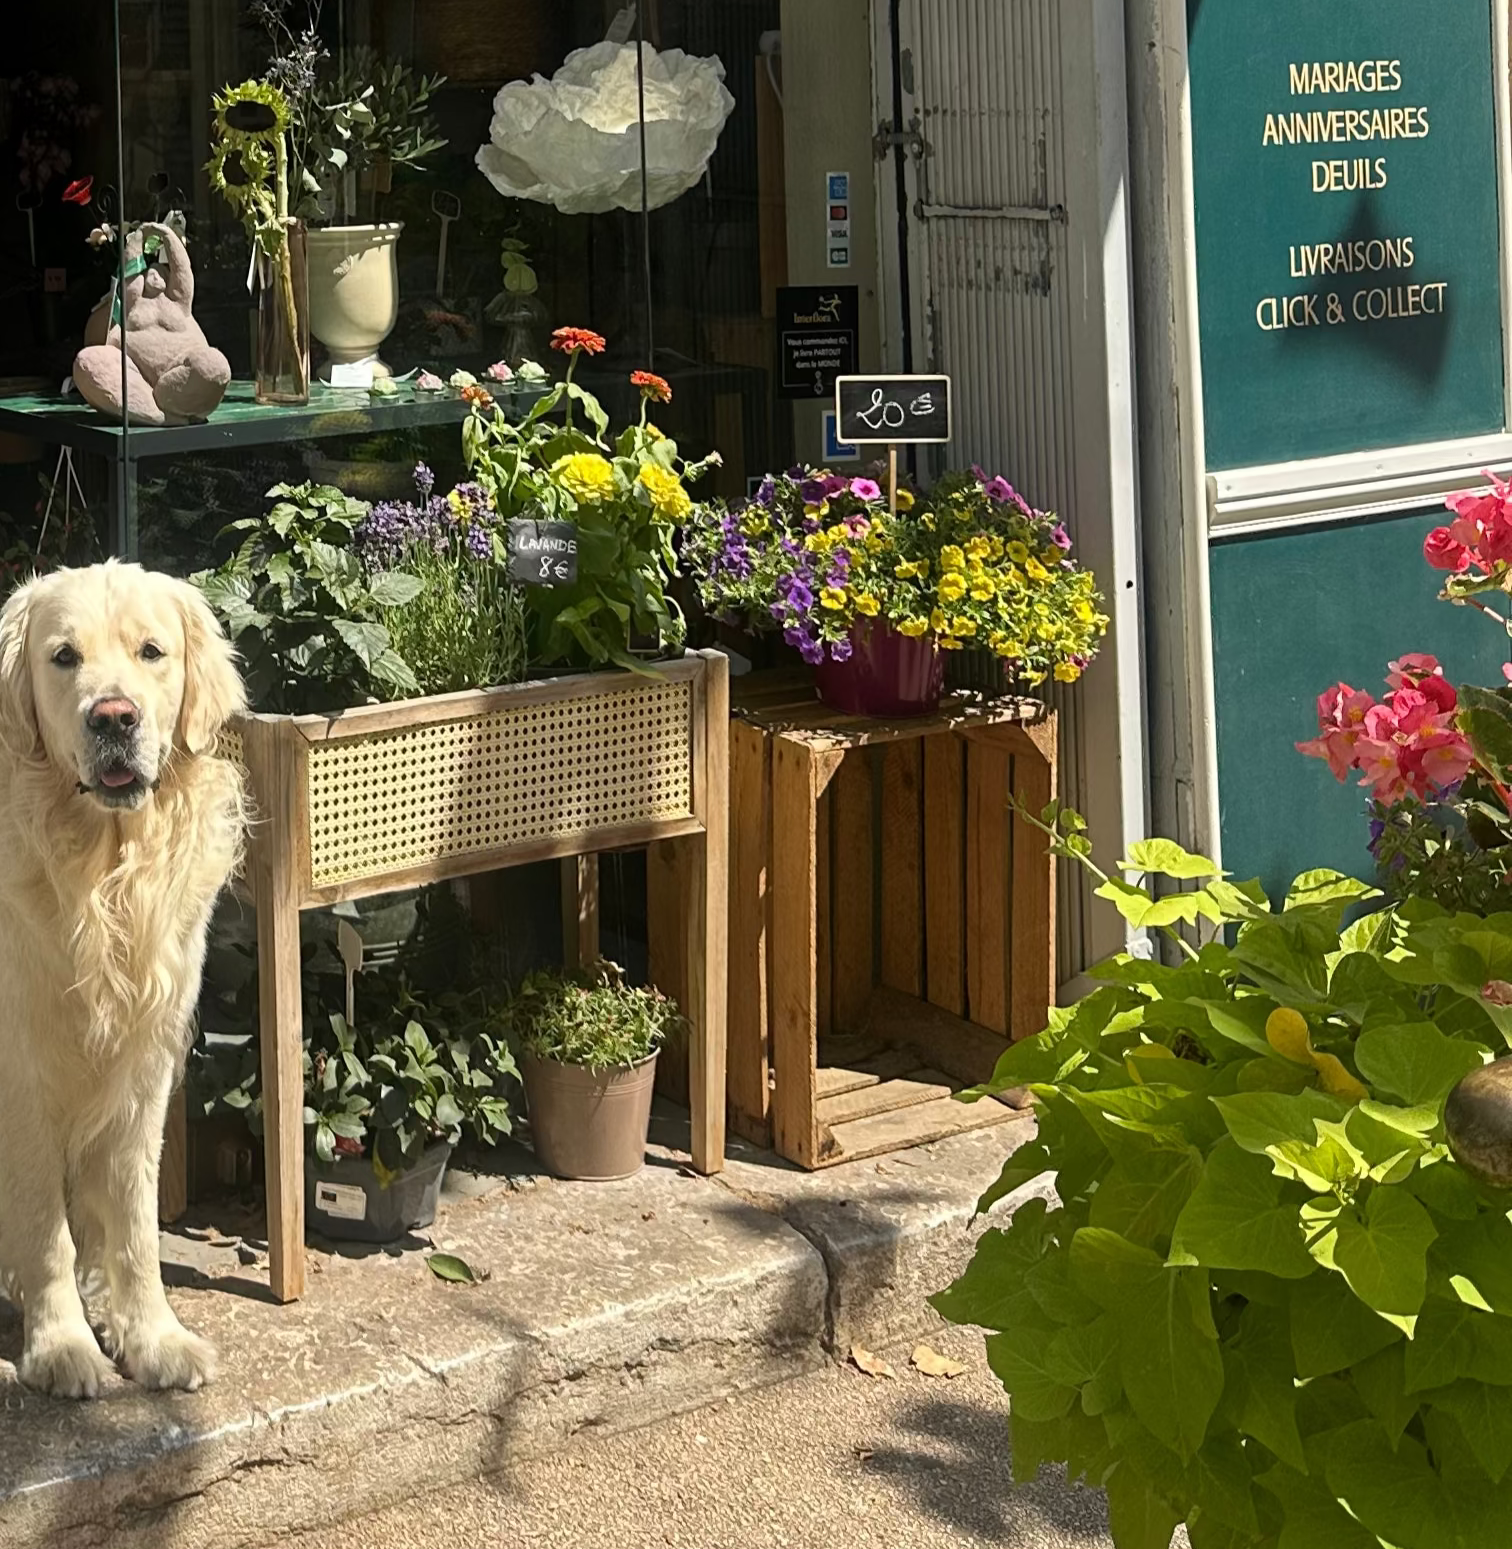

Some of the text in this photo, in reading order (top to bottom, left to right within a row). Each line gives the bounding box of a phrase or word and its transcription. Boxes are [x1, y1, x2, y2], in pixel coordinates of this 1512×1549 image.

[1289, 60, 1402, 94] MARIAGES
[1263, 107, 1429, 144] ANNIVERSAIRES
[1312, 158, 1387, 192] DEUILS
[1290, 237, 1414, 277] LIVRAISONS
[1256, 282, 1446, 330] CLICK & COLLECT
[519, 536, 578, 554] LAVANDE
